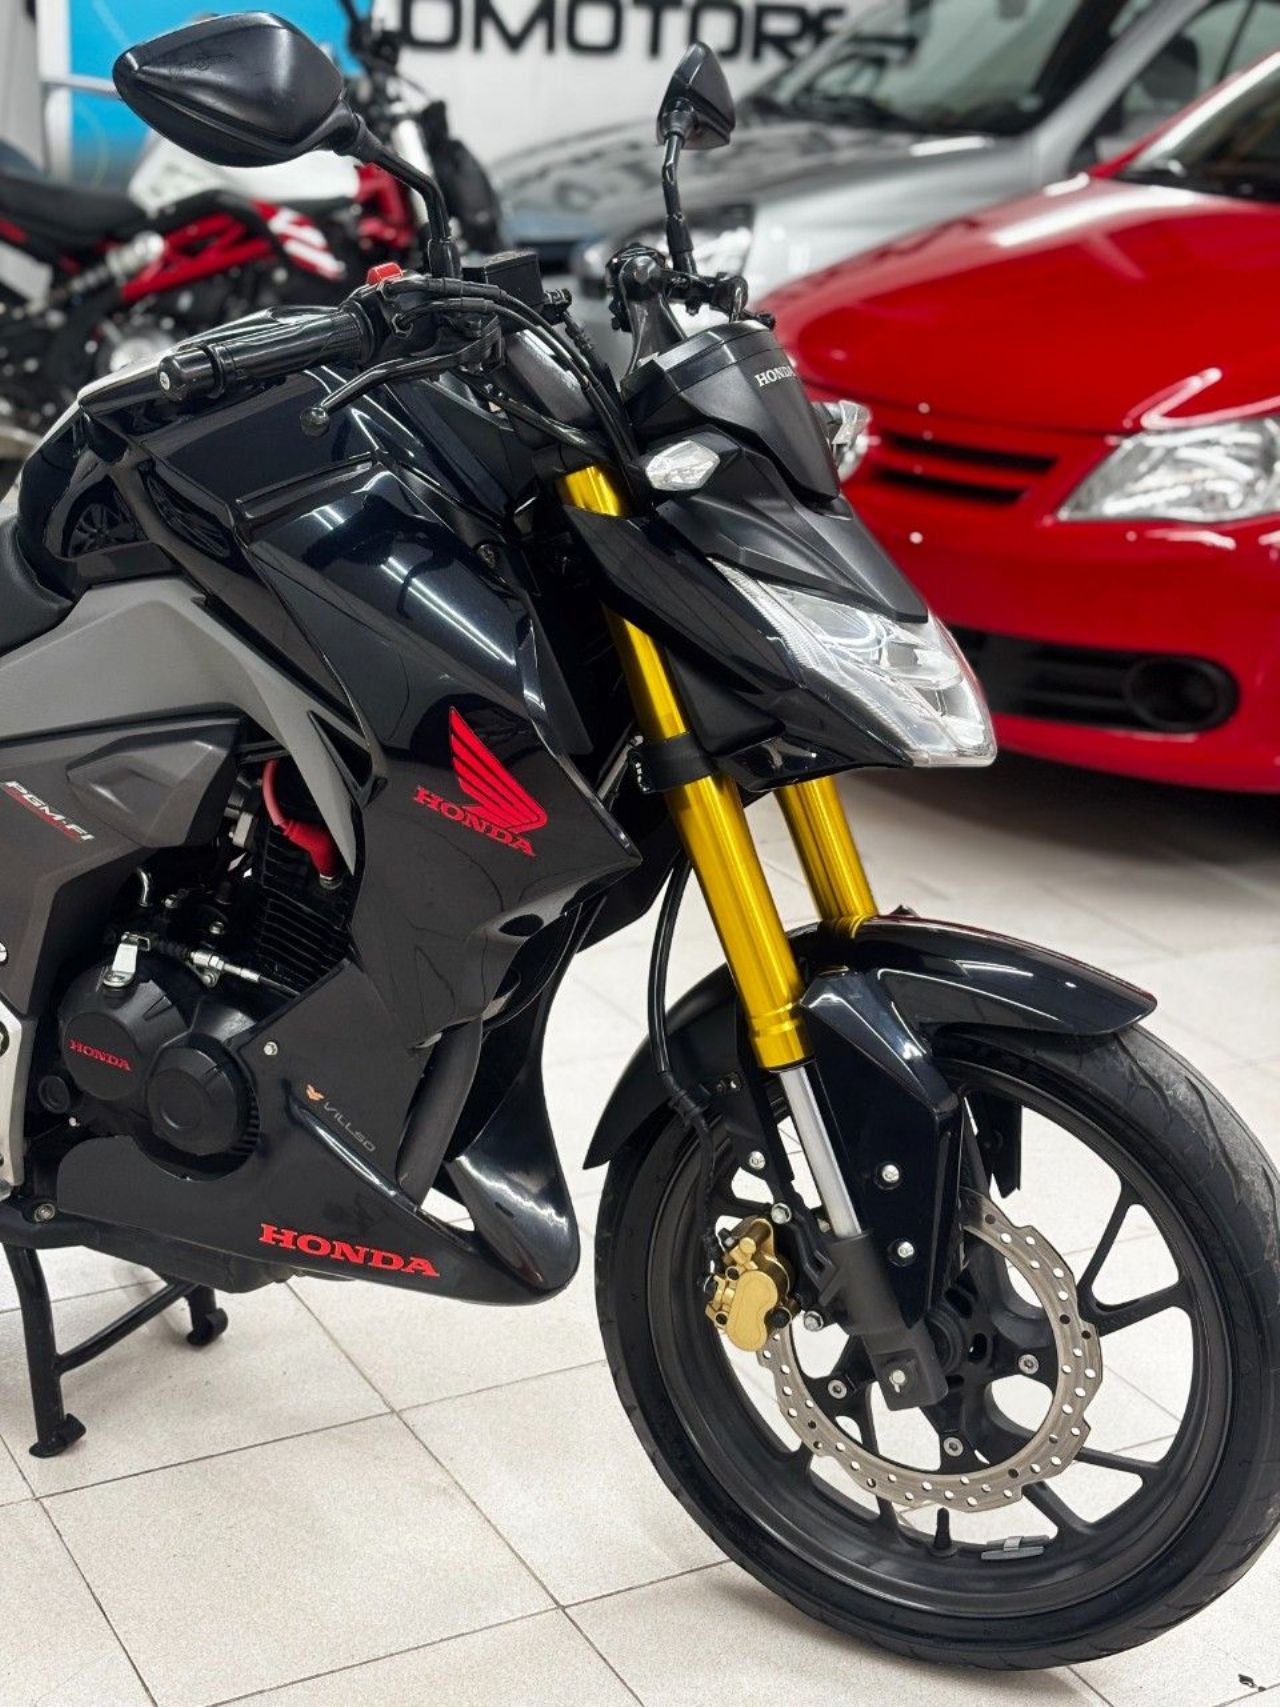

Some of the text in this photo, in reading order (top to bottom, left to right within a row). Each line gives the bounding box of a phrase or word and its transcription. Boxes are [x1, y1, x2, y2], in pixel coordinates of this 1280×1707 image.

[754, 366, 796, 387] HONDA
[414, 784, 536, 857] HONDA
[69, 1039, 132, 1072] HONDA
[259, 1223, 441, 1277] HONDA
